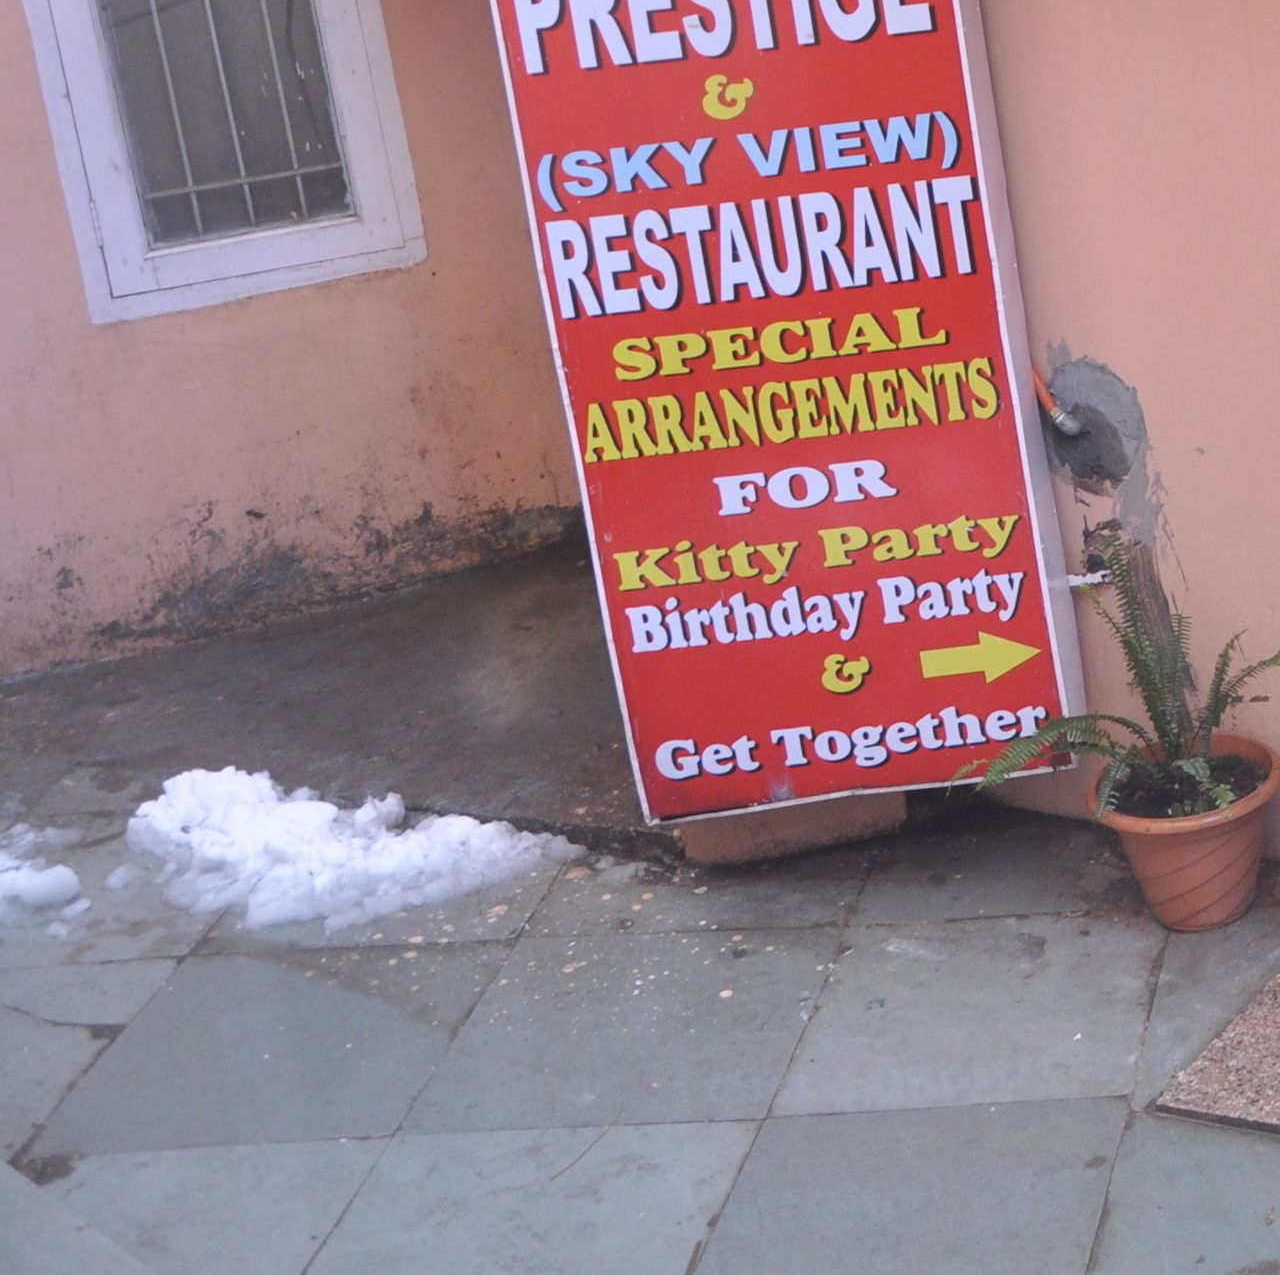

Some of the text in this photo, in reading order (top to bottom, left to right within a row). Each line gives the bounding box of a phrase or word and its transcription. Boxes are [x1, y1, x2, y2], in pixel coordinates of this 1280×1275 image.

[702, 74, 754, 120] &
[537, 111, 959, 212] (SKY VIEW)
[545, 174, 977, 320] RESTAURANT
[612, 308, 948, 382] SPECIAL
[584, 357, 1001, 464] ARRANGEMENTS
[712, 459, 897, 517] FOR
[613, 515, 1020, 592] Kitty Party
[625, 570, 1025, 654] Birthday Party
[821, 654, 870, 694] &
[654, 706, 1047, 781] Get Together
